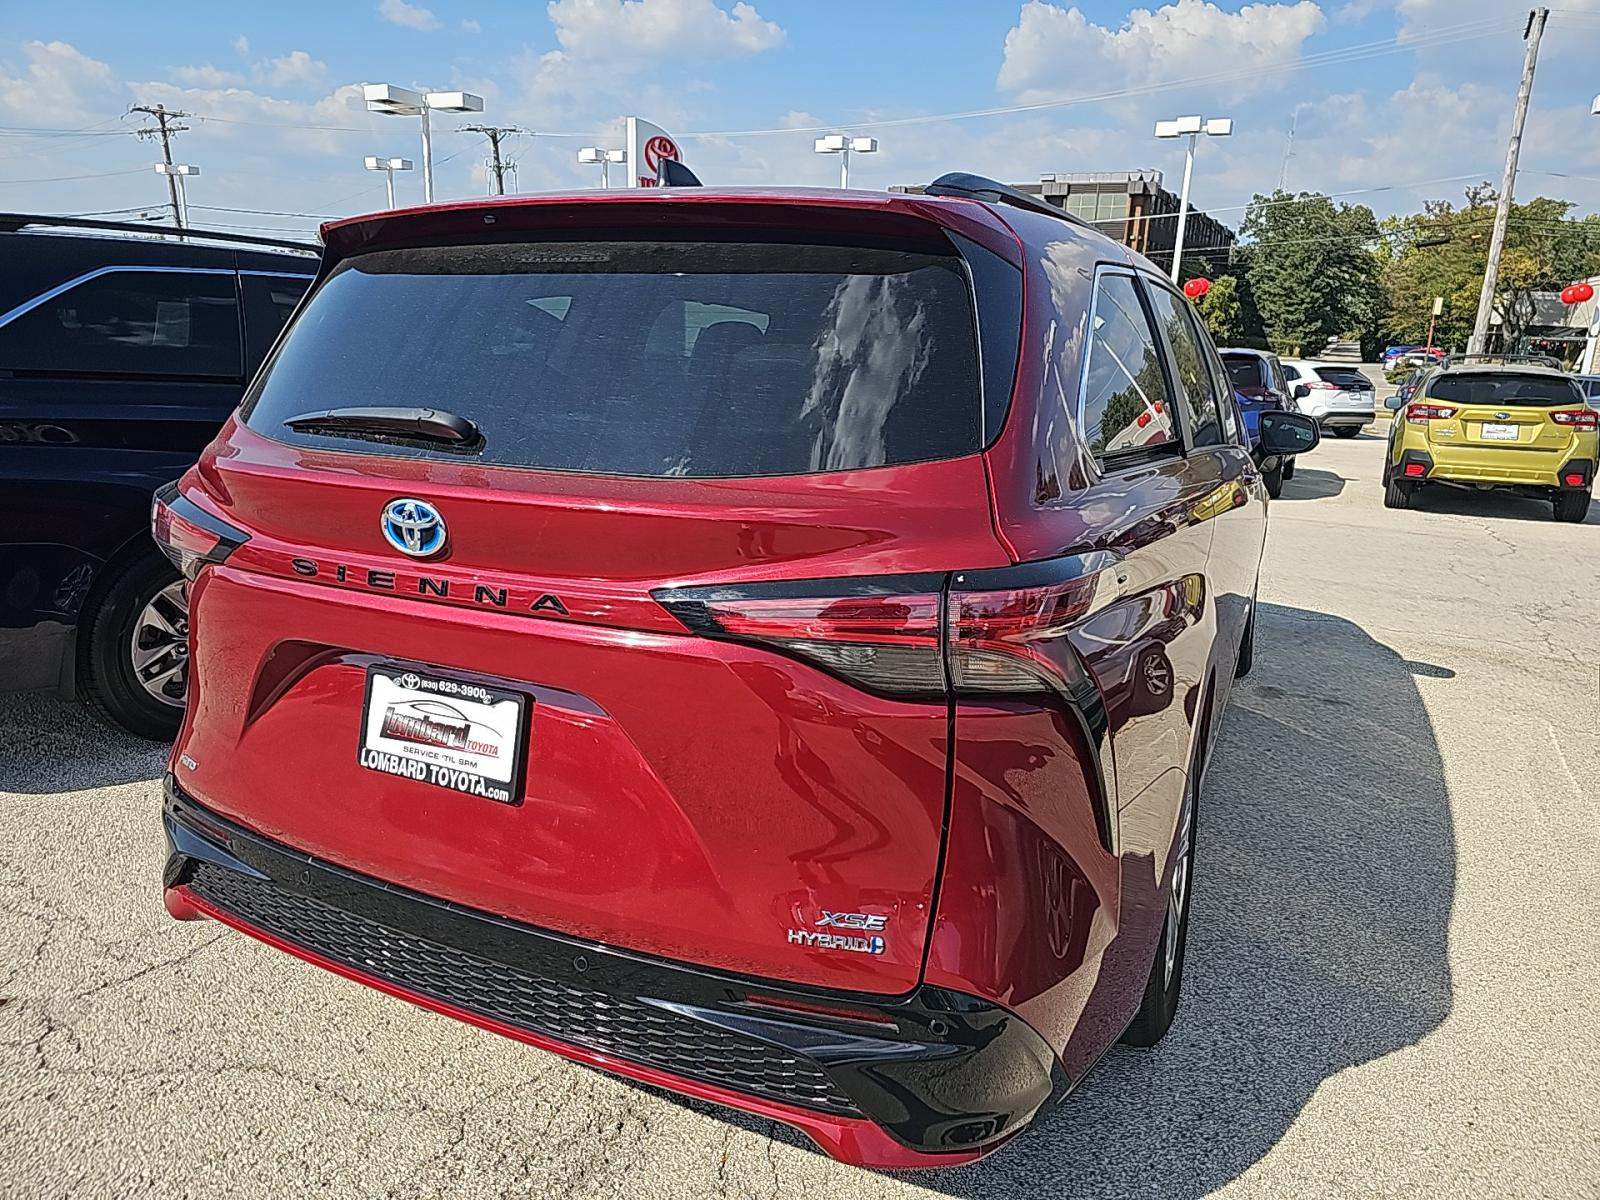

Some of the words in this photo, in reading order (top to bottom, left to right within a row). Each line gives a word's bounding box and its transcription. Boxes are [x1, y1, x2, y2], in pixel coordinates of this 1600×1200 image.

[291, 558, 570, 615] SIENNA
[421, 679, 438, 691] (630)
[439, 681, 486, 698] 629-3900
[403, 746, 439, 760] SERVICE
[467, 740, 499, 756] TOYOTA
[360, 747, 427, 781] LOMBARD
[430, 766, 509, 802] TOYOTA.com
[815, 910, 888, 931] XSE
[787, 928, 868, 953] HYBRID
